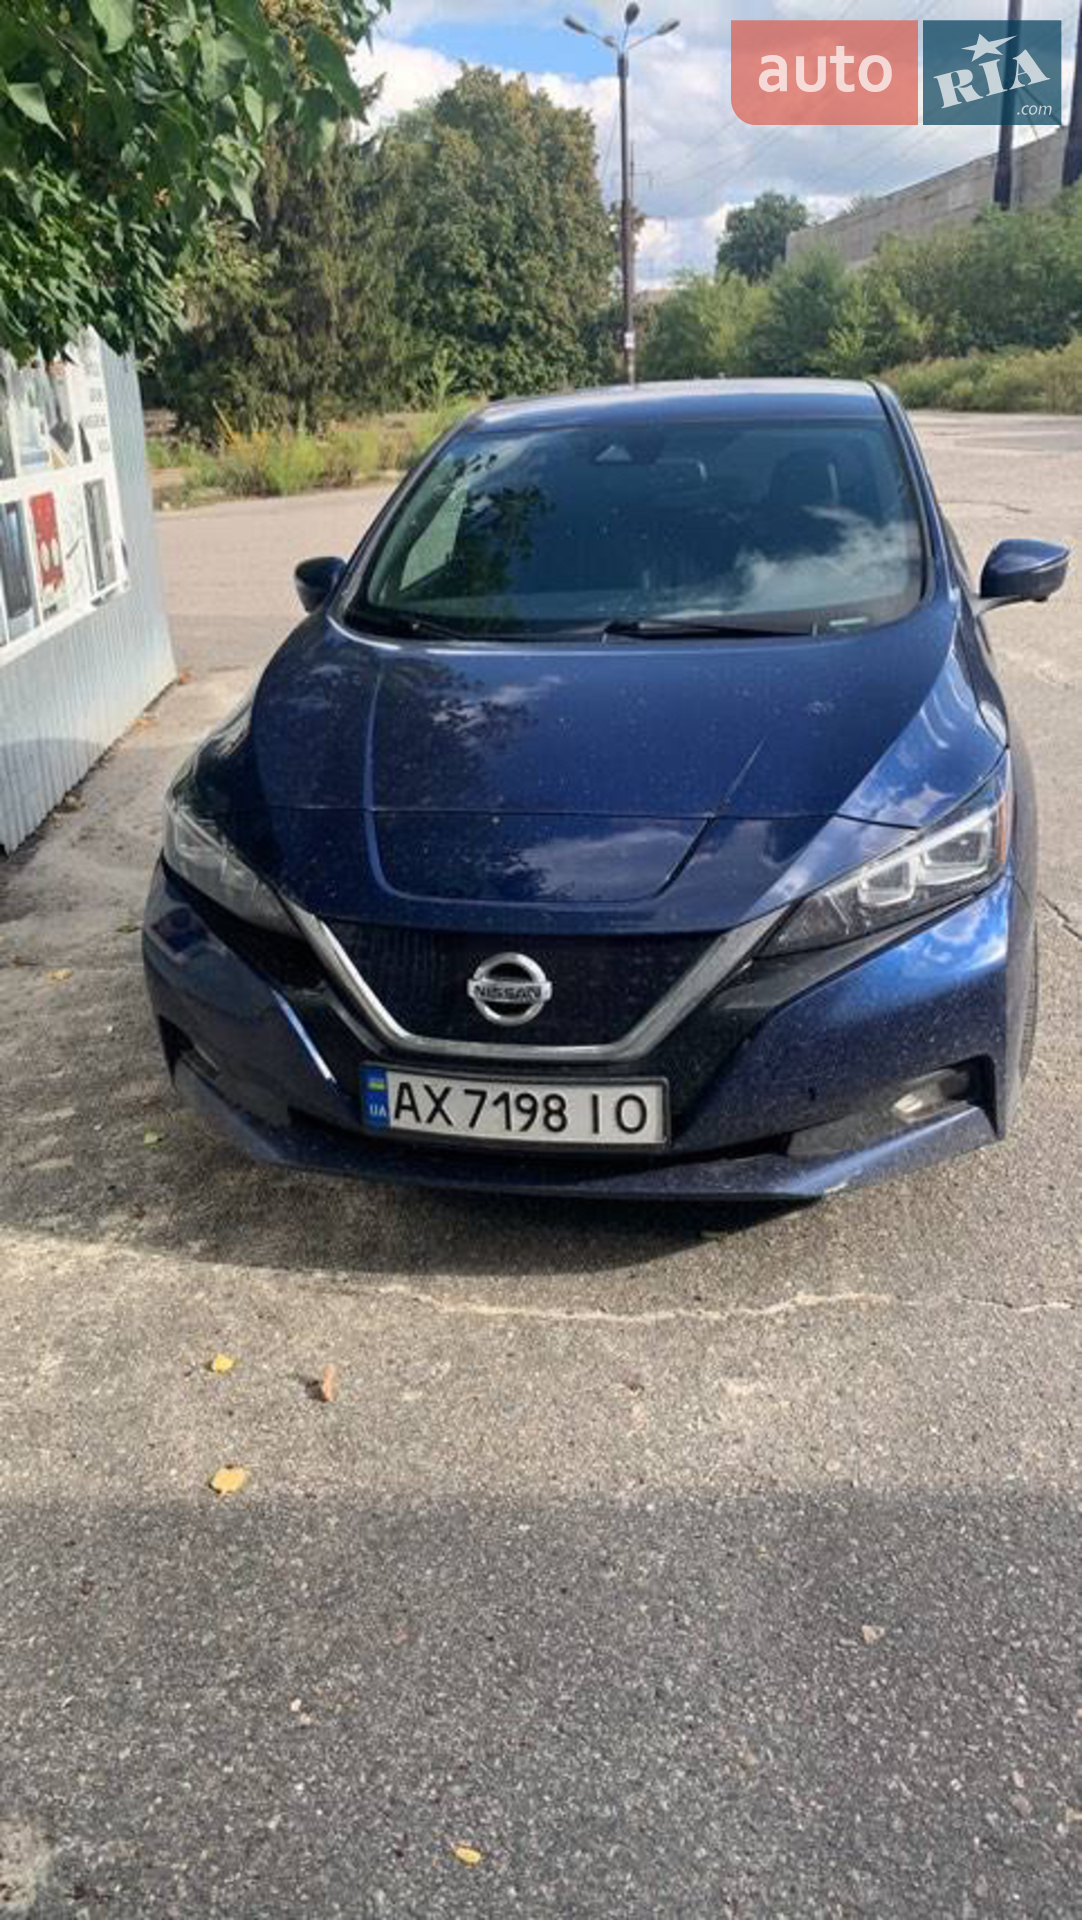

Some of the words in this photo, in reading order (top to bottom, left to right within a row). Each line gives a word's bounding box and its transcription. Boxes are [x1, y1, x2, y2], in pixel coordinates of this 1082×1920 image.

[473, 984, 541, 1000] NISSAN
[369, 1105, 386, 1117] UA
[394, 1082, 453, 1127] AX
[464, 1088, 568, 1134] 7198
